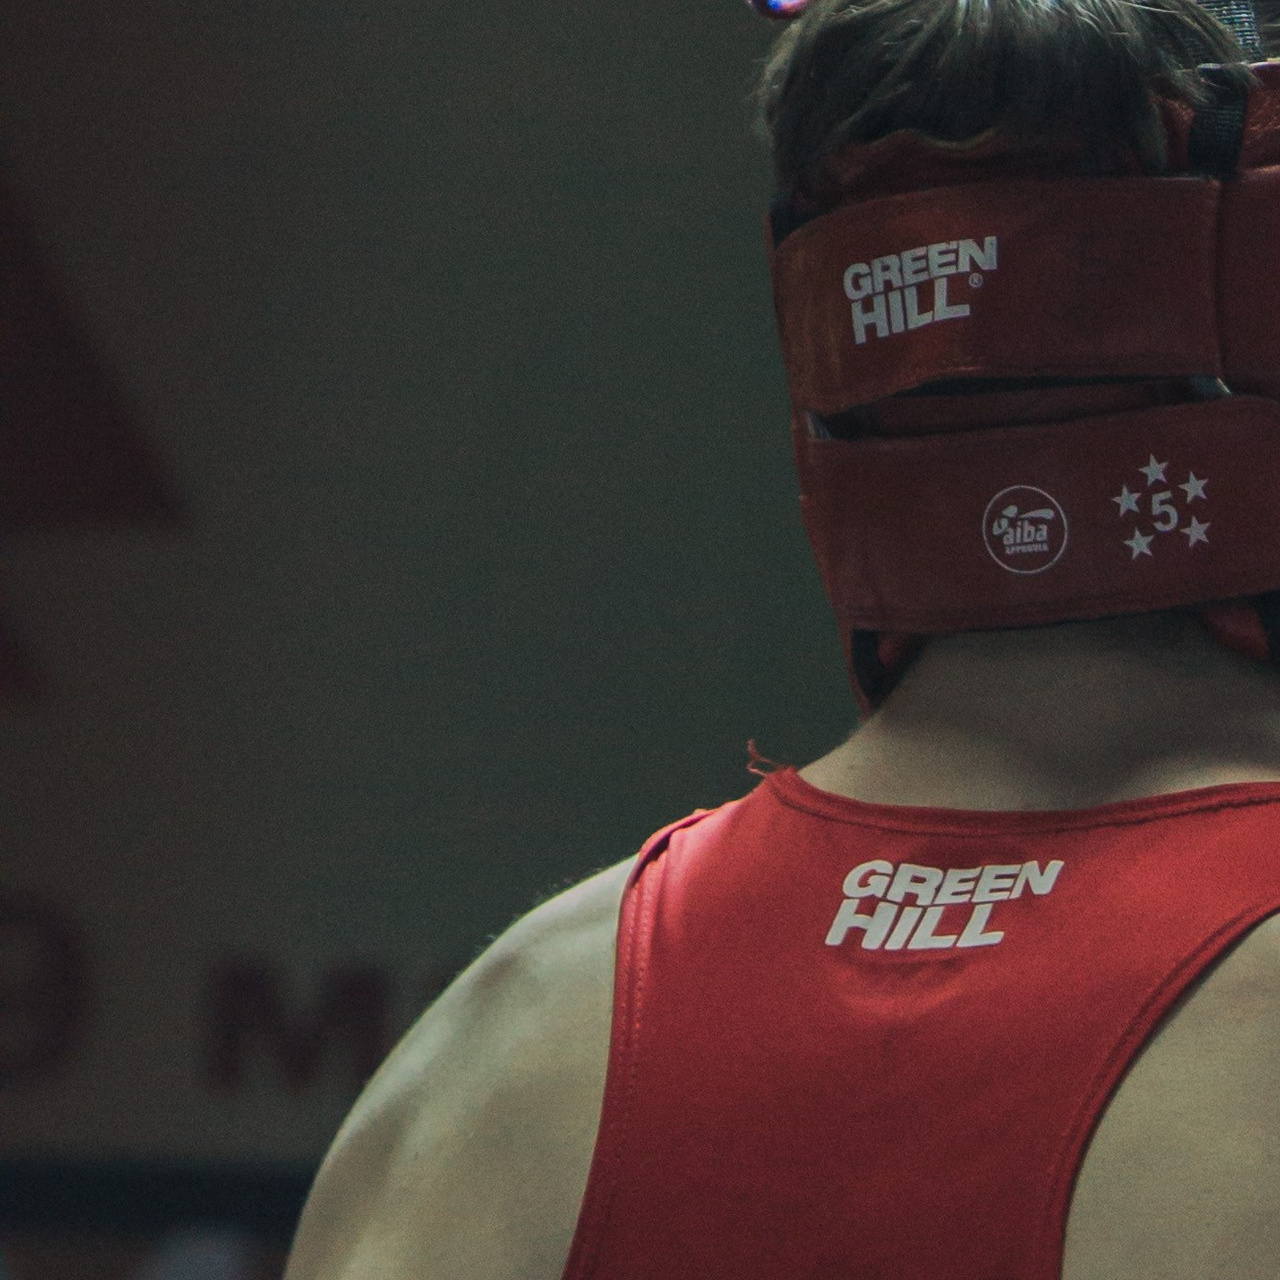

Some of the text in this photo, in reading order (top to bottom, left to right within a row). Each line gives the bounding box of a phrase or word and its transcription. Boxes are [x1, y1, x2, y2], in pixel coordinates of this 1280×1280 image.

[843, 235, 998, 300] GREEN
[850, 277, 971, 345] HILL
[1003, 520, 1048, 545] aiba
[1151, 491, 1179, 533] 5
[842, 859, 1065, 907] GREEN
[824, 898, 1005, 951] HILL
